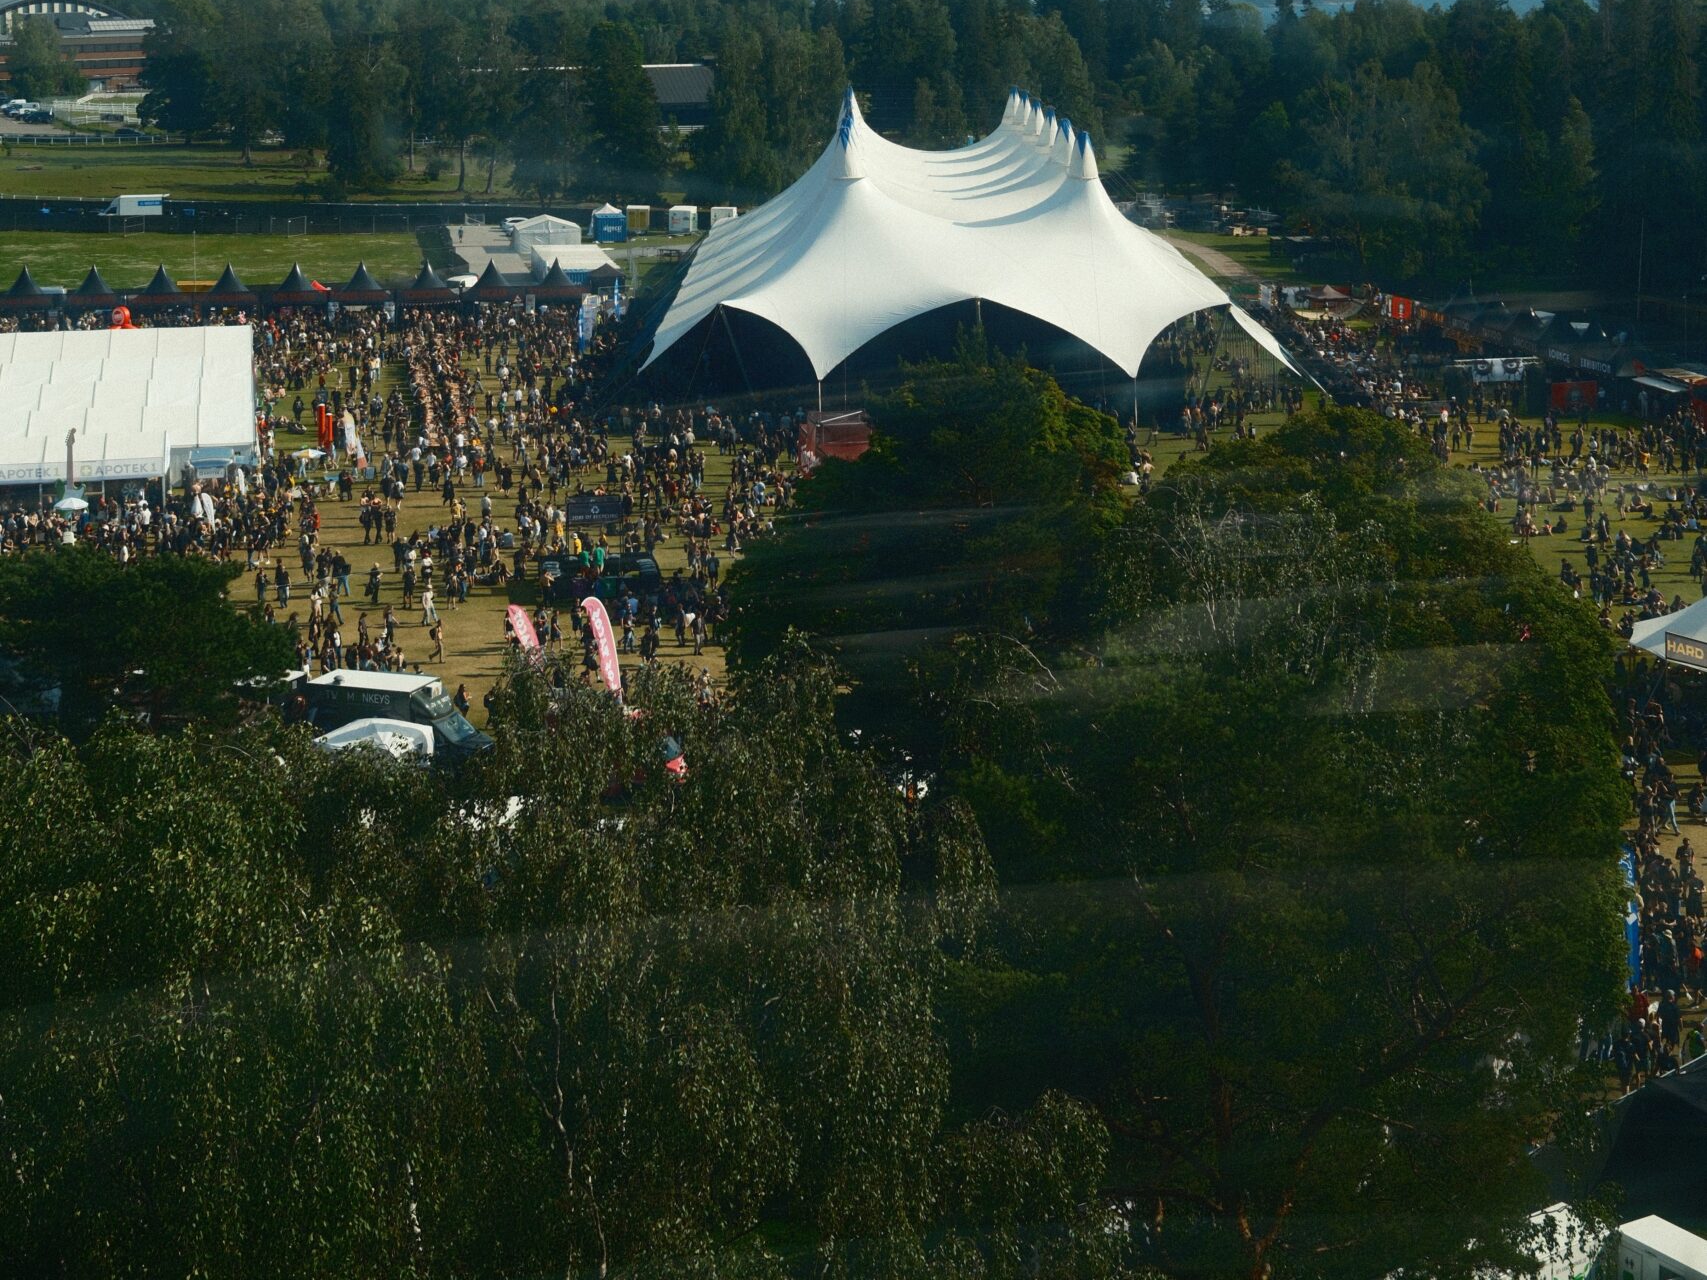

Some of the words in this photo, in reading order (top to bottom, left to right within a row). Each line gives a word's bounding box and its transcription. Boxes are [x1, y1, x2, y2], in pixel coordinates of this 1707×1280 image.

[1580, 357, 1612, 375] EXHIBITION
[0, 467, 51, 480] APOTEK
[53, 466, 60, 477] 1
[95, 462, 148, 475] APOTEK
[150, 462, 157, 472] 1
[1667, 639, 1704, 660] HARD
[346, 691, 391, 705] MNKEYS
